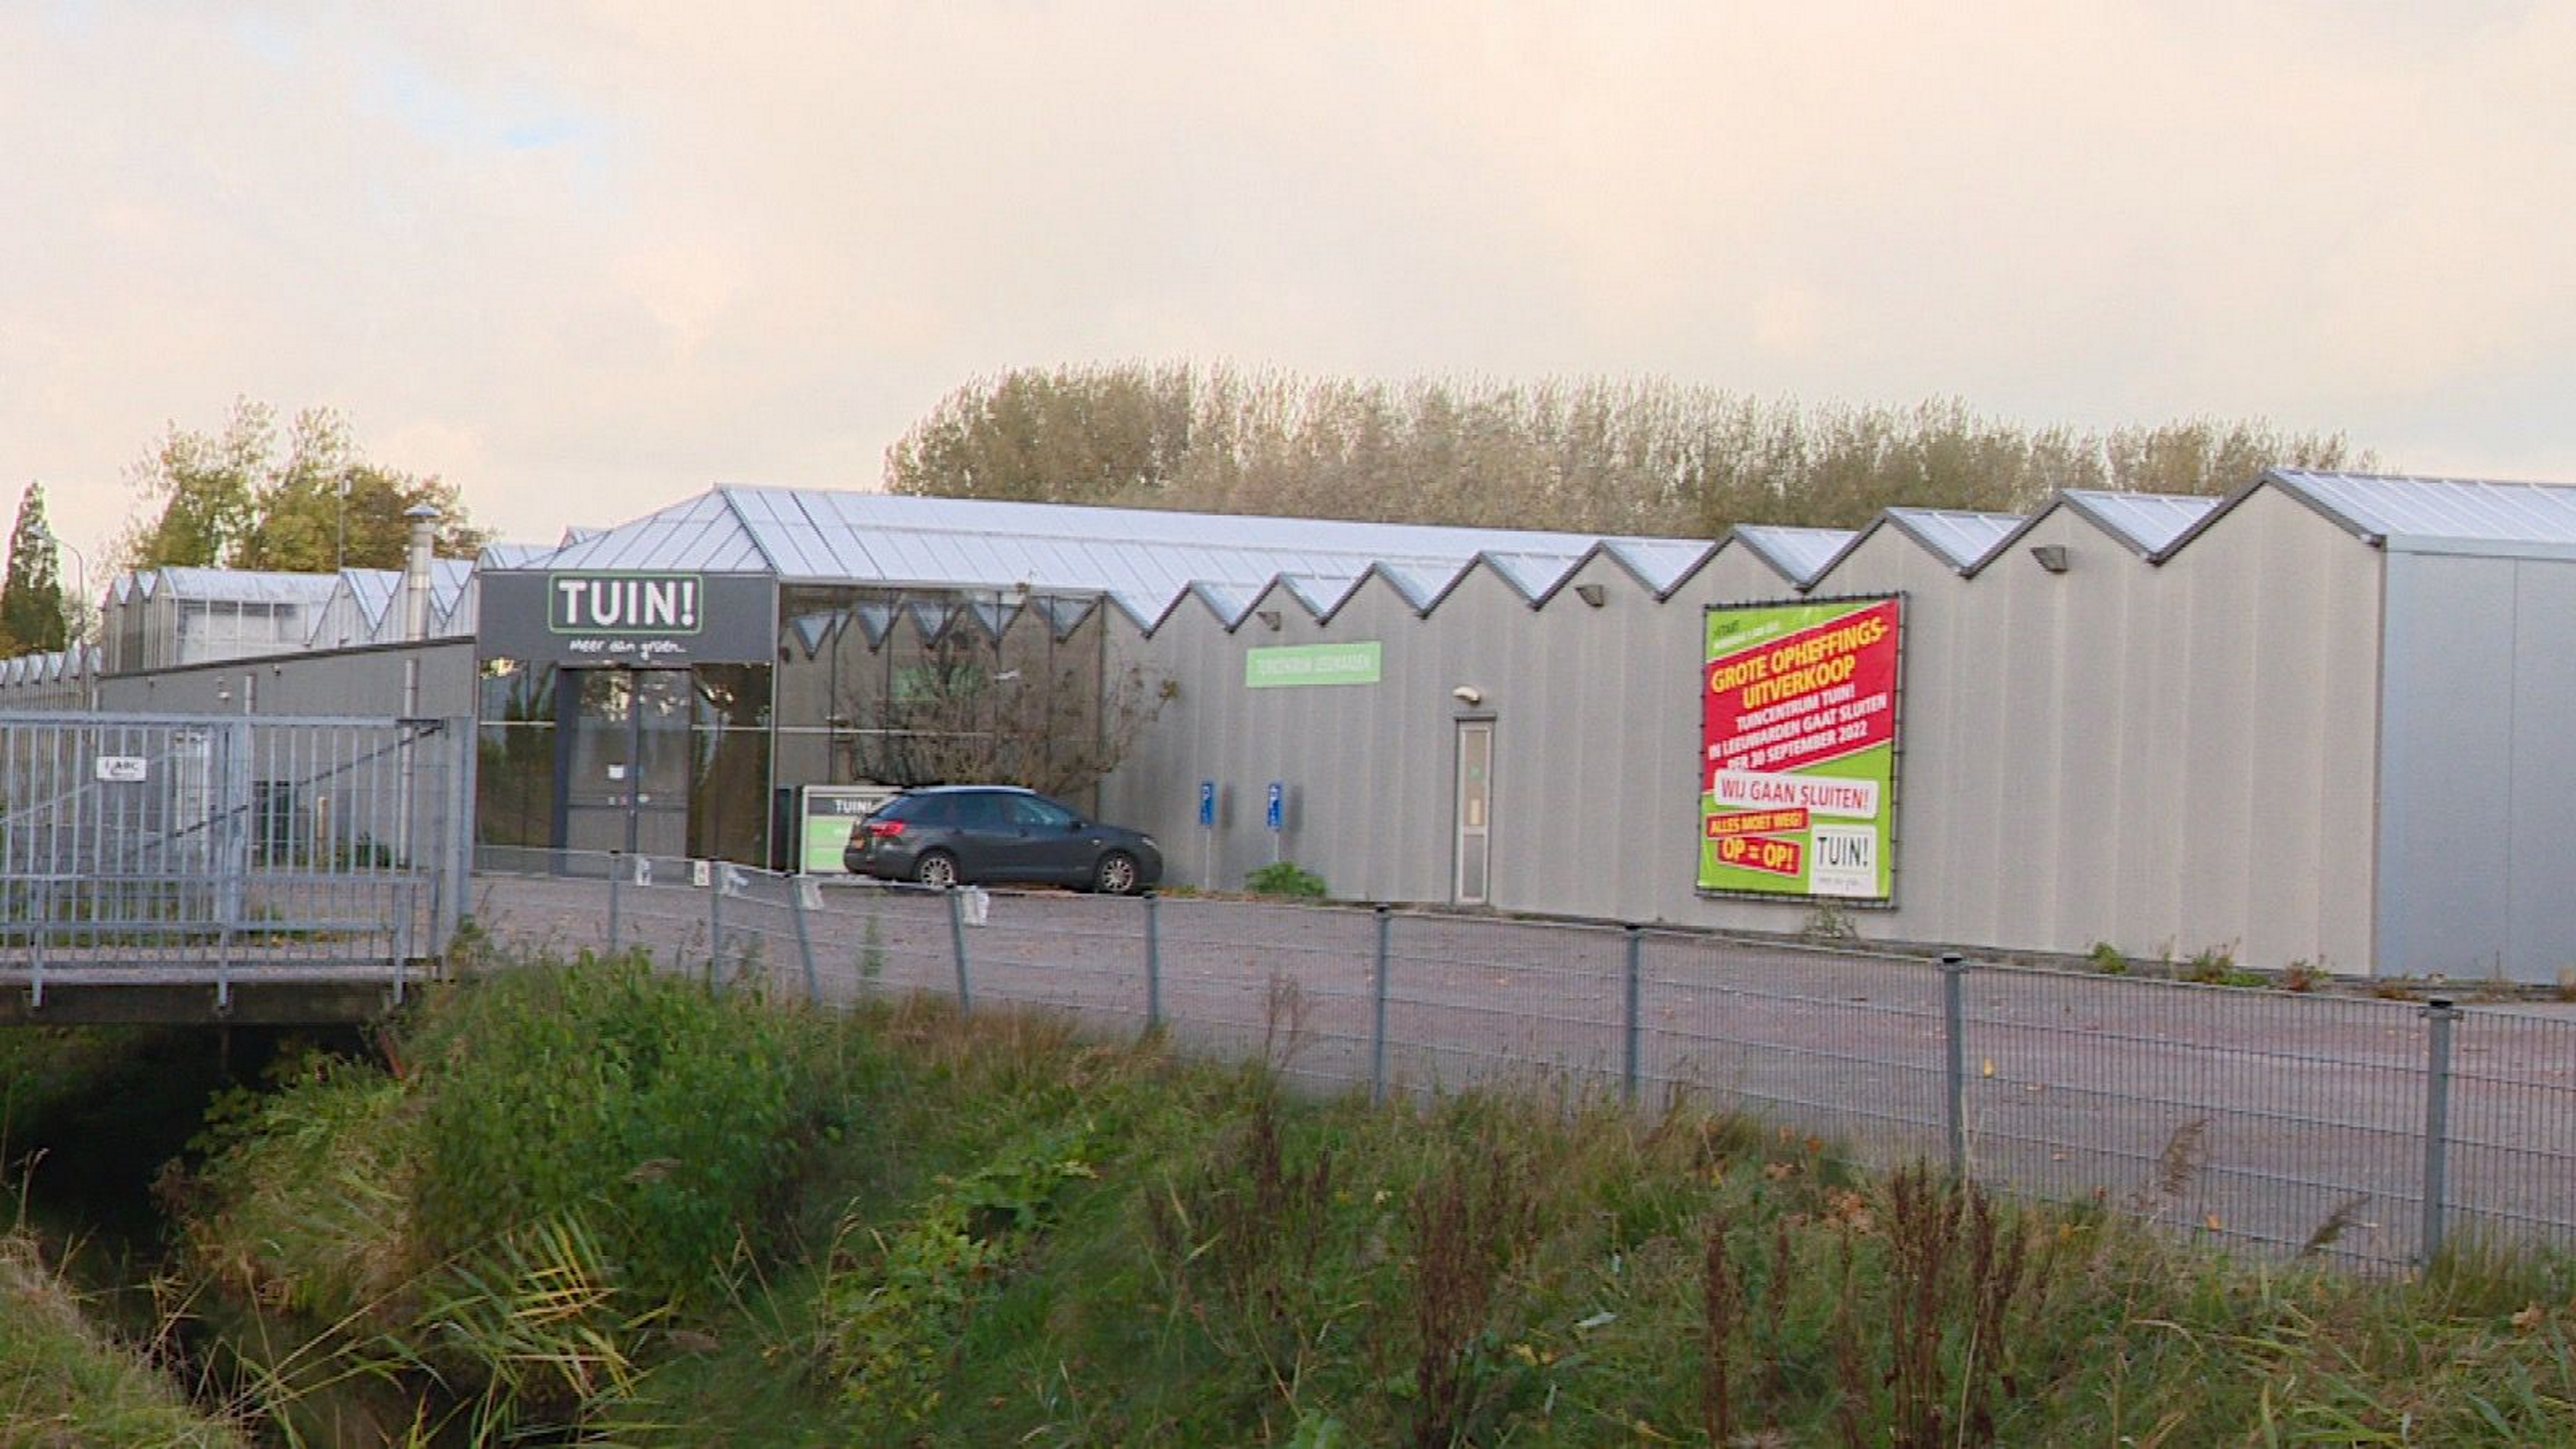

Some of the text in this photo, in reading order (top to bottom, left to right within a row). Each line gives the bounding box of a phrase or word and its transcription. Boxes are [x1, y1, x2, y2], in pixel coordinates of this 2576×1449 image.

[558, 579, 696, 626] TUIN!
[1711, 656, 1768, 693] GROTE
[1771, 616, 1888, 672] OPHEFFINGS-
[1743, 654, 1856, 709] UITVERKOOP
[1709, 692, 1887, 760] IN LEEUWARDEN GAAT SLUITEN
[1736, 683, 1855, 731] TUINCENTRUM TUIN!
[1766, 730, 1837, 762] SEPTEMBER
[1838, 720, 1868, 743] 2022
[1722, 779, 1868, 811] WIJ GAAN SLUITEN!
[1710, 819, 1740, 834] ALLES
[1741, 815, 1772, 831] MOET
[1722, 836, 1745, 859] OP
[1763, 842, 1793, 870] OP!
[1817, 837, 1869, 869] TUIN!
